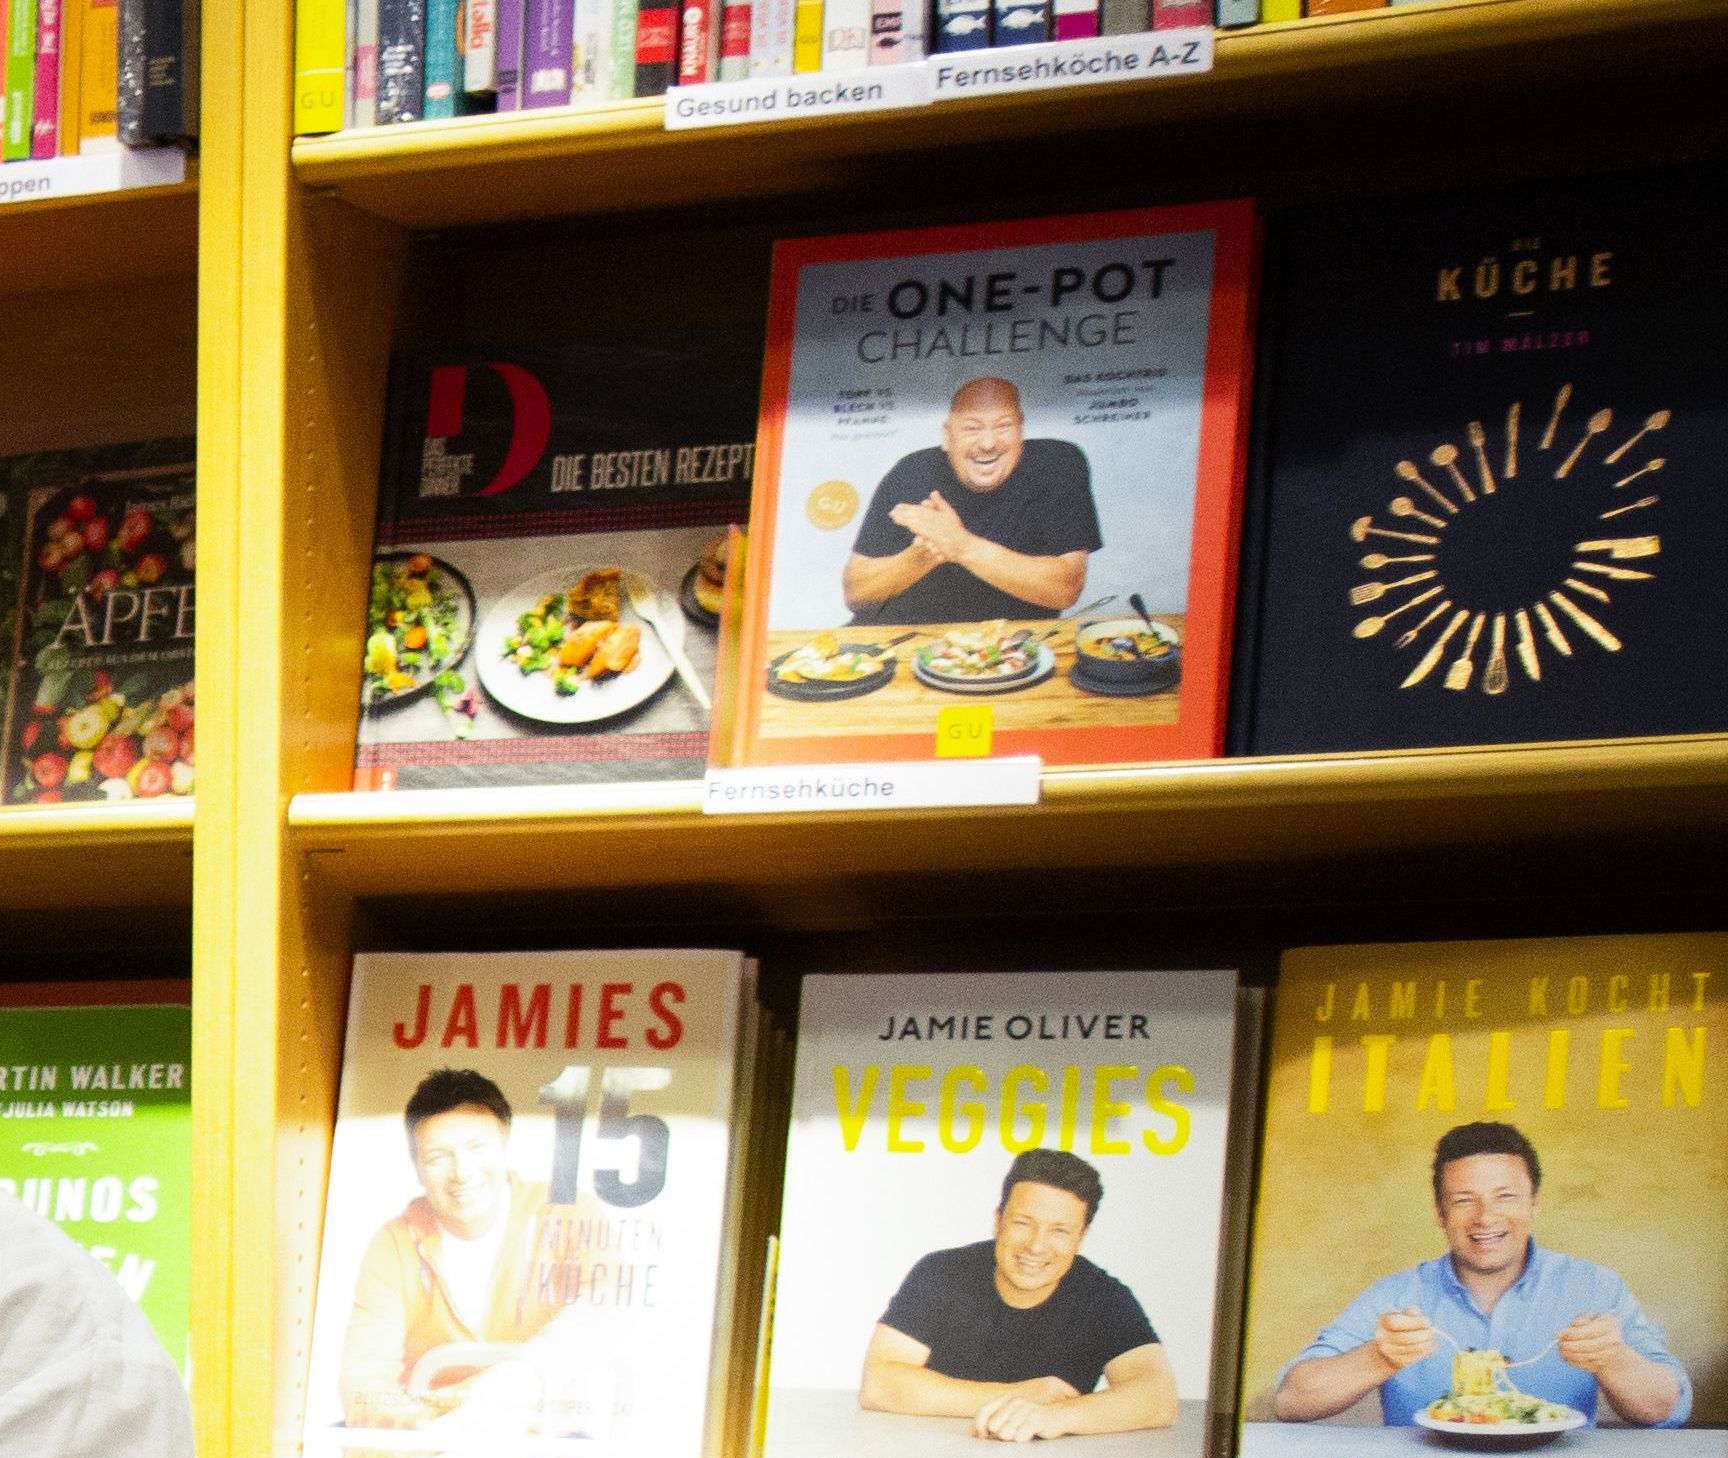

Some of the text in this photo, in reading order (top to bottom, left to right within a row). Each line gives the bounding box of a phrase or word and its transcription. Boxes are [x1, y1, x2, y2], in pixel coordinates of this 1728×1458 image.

[937, 41, 1201, 90] Fernsehköche A-Z
[676, 79, 884, 119] Gesund backen
[830, 257, 1178, 321] DIE ONE-POT
[1436, 250, 1617, 304] KÜCHE
[856, 309, 1141, 365] CHALLENGE
[549, 453, 587, 494] DIE
[589, 448, 671, 490] BESTEN
[947, 721, 985, 741] GU
[707, 776, 895, 803] Fernsehküche
[391, 980, 688, 1053] JAMIES
[1314, 971, 1713, 1023] JAMIE KOCHT
[878, 1013, 1152, 1042] JAMIE OLIVER
[70, 1062, 185, 1090] WALKER
[1305, 1025, 1708, 1115] ITALIEN
[2, 1100, 134, 1120] JULIA WATSON
[830, 1062, 1197, 1158] VEGGIES
[538, 1064, 677, 1210] 15
[536, 1255, 659, 1309] KÜCHE
